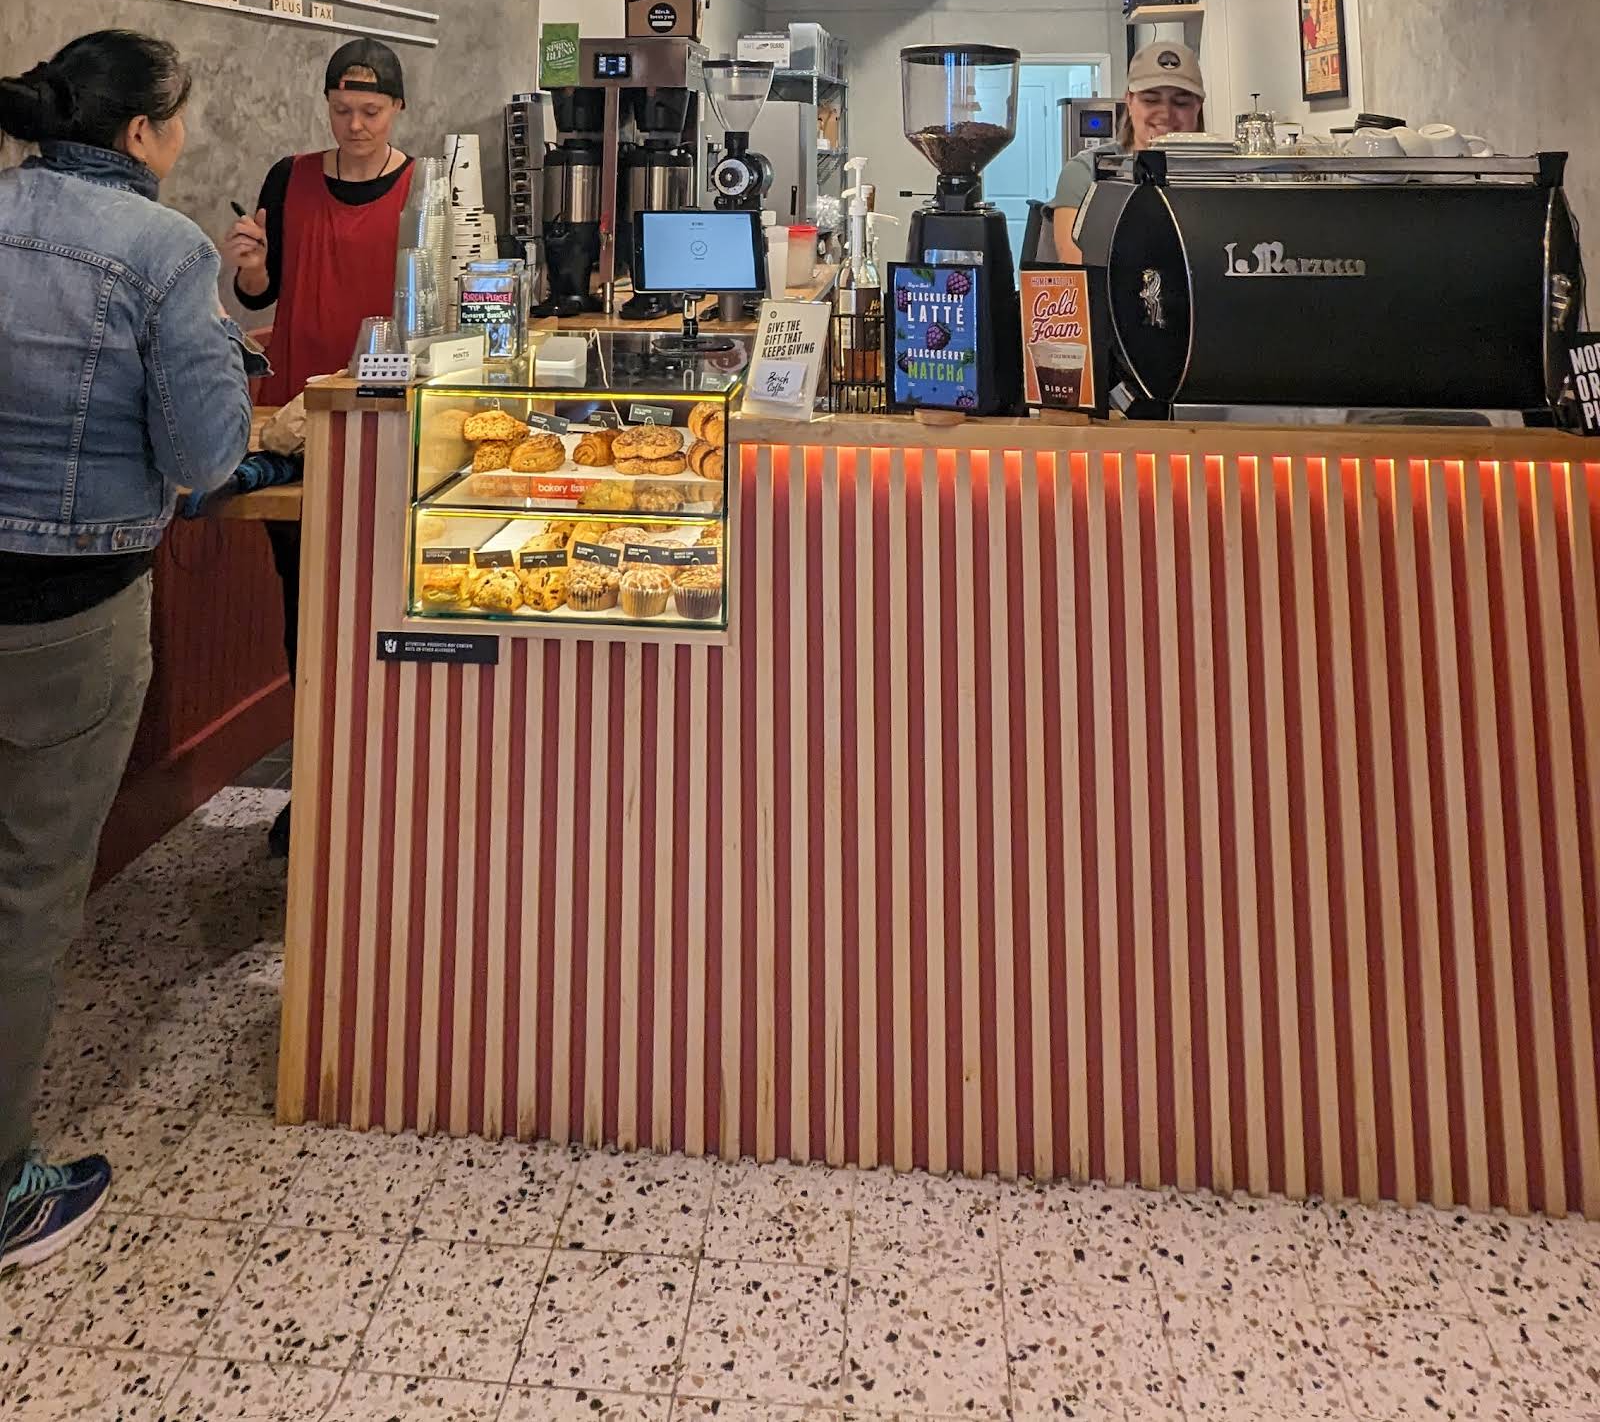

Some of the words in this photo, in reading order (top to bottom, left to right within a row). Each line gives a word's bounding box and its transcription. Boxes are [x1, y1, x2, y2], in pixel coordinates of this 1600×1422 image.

[274, 0, 301, 13] PLUS
[313, 6, 332, 19] TAX
[907, 292, 964, 303] BLACKBERRY
[1033, 288, 1078, 318] Cold
[907, 304, 964, 325] LATTÉ
[766, 321, 785, 333] GIVE
[786, 319, 801, 332] THE
[1031, 317, 1082, 343] Foam
[764, 333, 782, 345] GIFT
[783, 331, 803, 344] THAT
[761, 345, 786, 358] KEEPS
[787, 342, 815, 355] GIVING
[907, 348, 965, 361] BLACKBERRY
[907, 361, 964, 382] MATCHA
[1044, 384, 1074, 394] BIRCH
[538, 483, 568, 494] bakery
